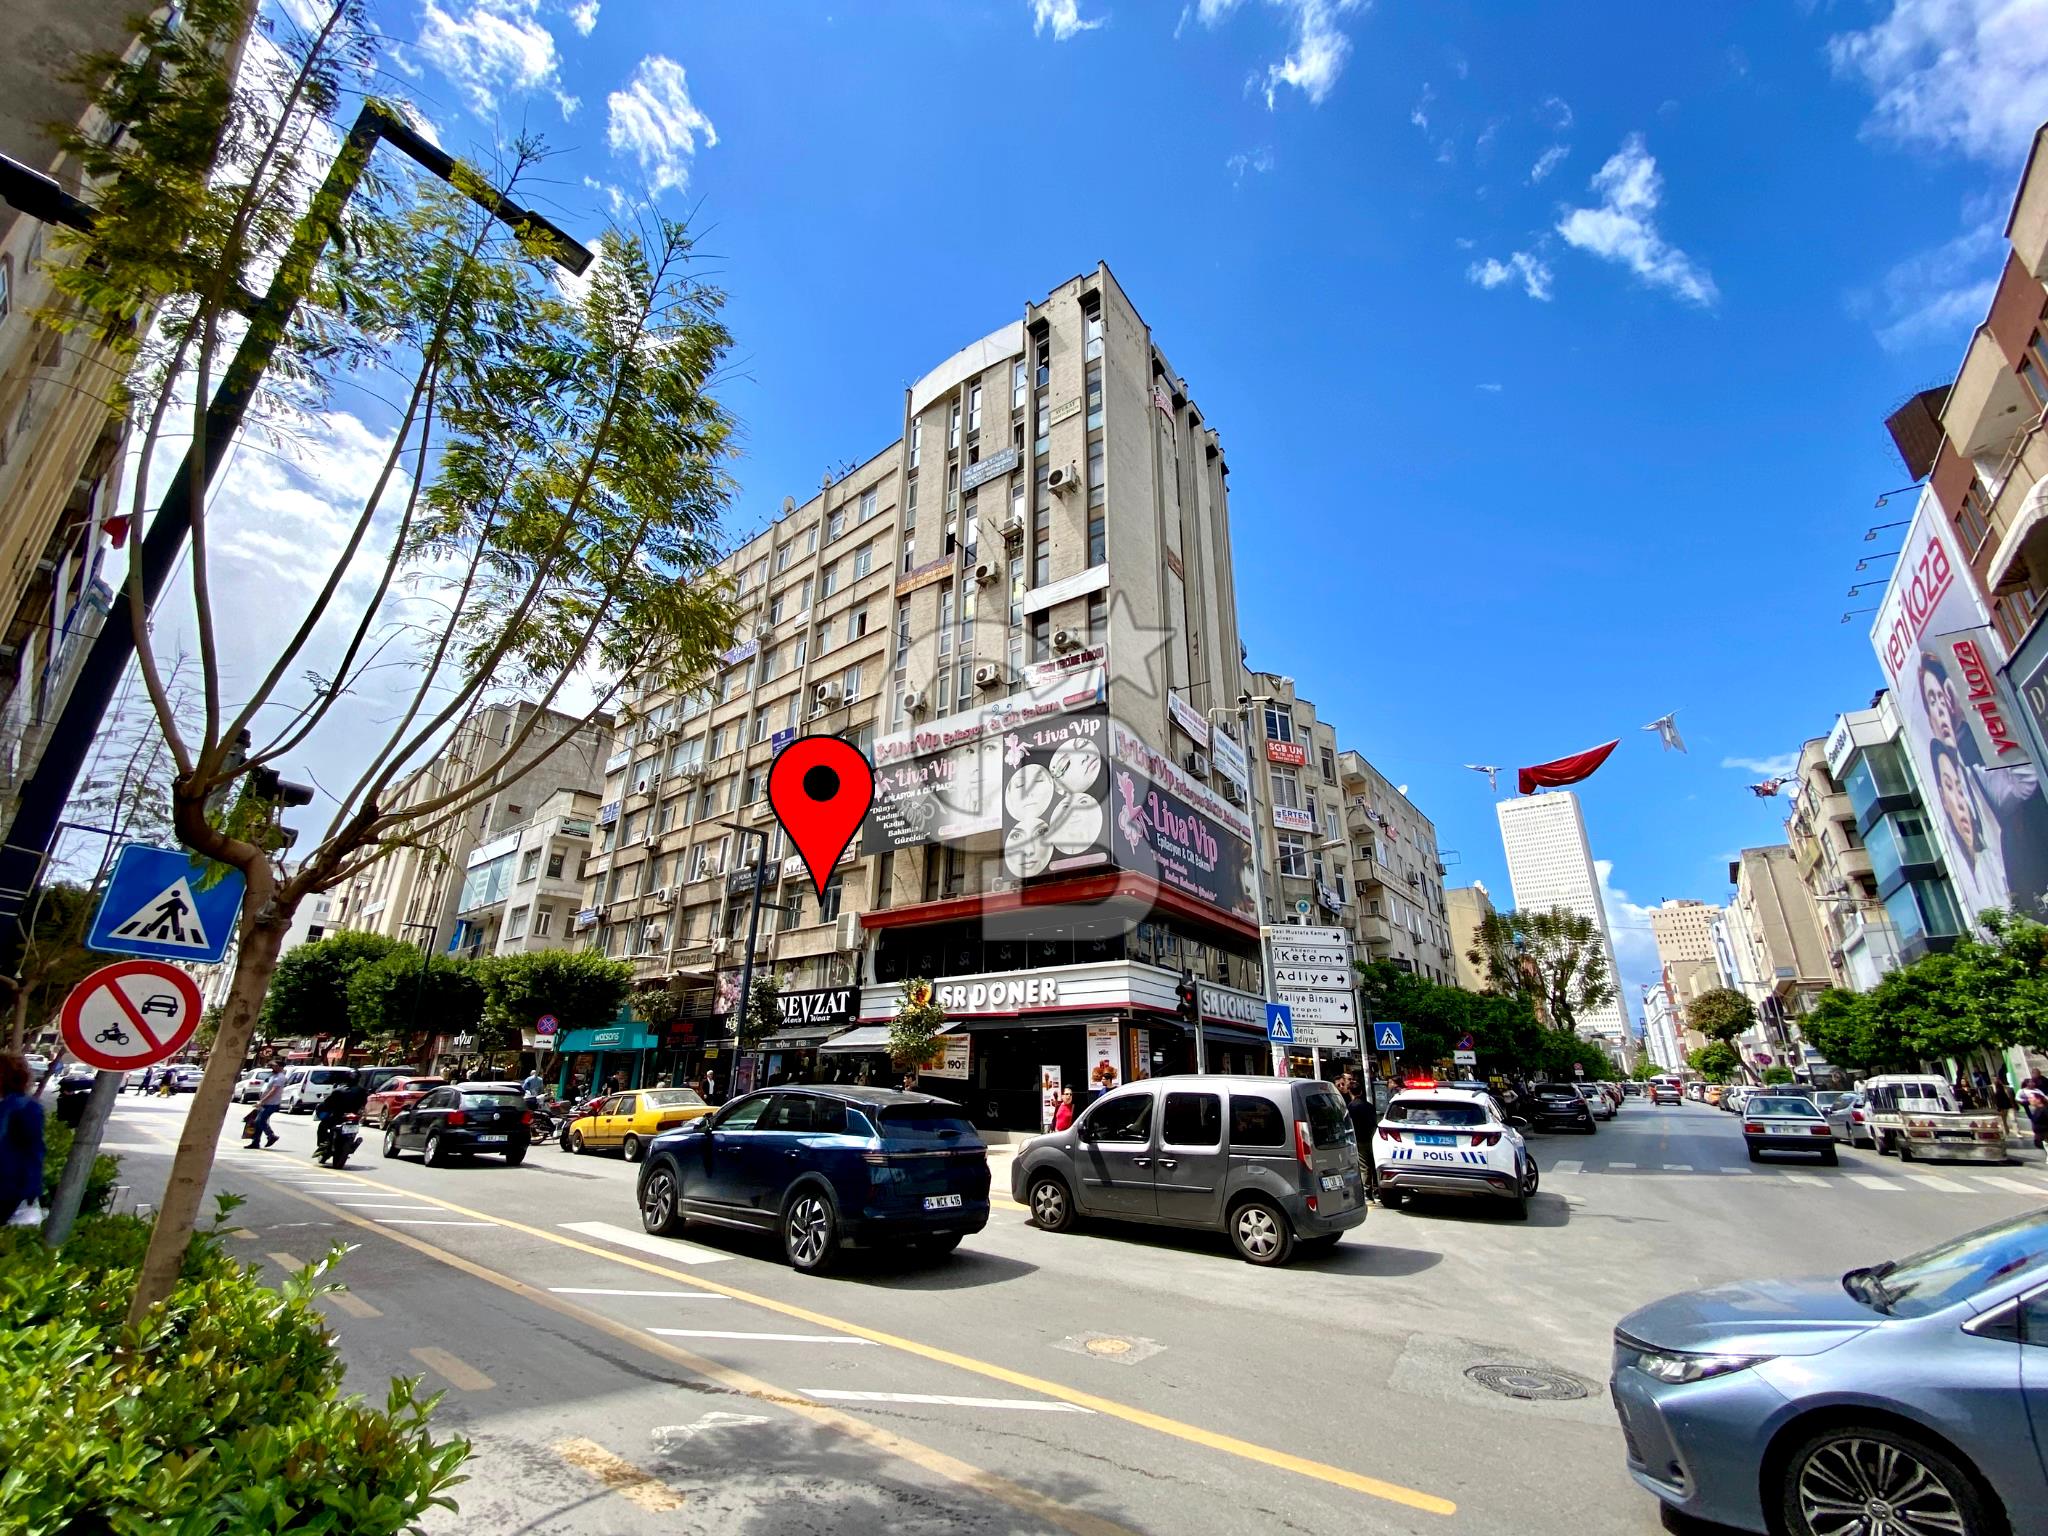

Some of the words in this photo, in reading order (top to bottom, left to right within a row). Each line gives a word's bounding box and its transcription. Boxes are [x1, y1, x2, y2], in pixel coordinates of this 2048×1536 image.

[1033, 727, 1069, 747] Liva
[1070, 718, 1100, 737] Vip
[894, 767, 929, 787] Liva
[929, 758, 957, 780] Vip
[1281, 809, 1310, 821] ERTEN
[1147, 791, 1190, 847] Liva
[1188, 815, 1218, 872] Vip
[1281, 950, 1333, 964] Ketem
[1275, 970, 1330, 985] Adliye
[940, 984, 967, 1008] SR
[1202, 989, 1218, 1014] SR
[1276, 992, 1306, 1005] Maliye
[1308, 994, 1337, 1005] Binası
[775, 991, 851, 1024] NEVZAT
[594, 1031, 620, 1042] watsons
[947, 1059, 962, 1070] 190
[1423, 1150, 1454, 1162] POLİS
